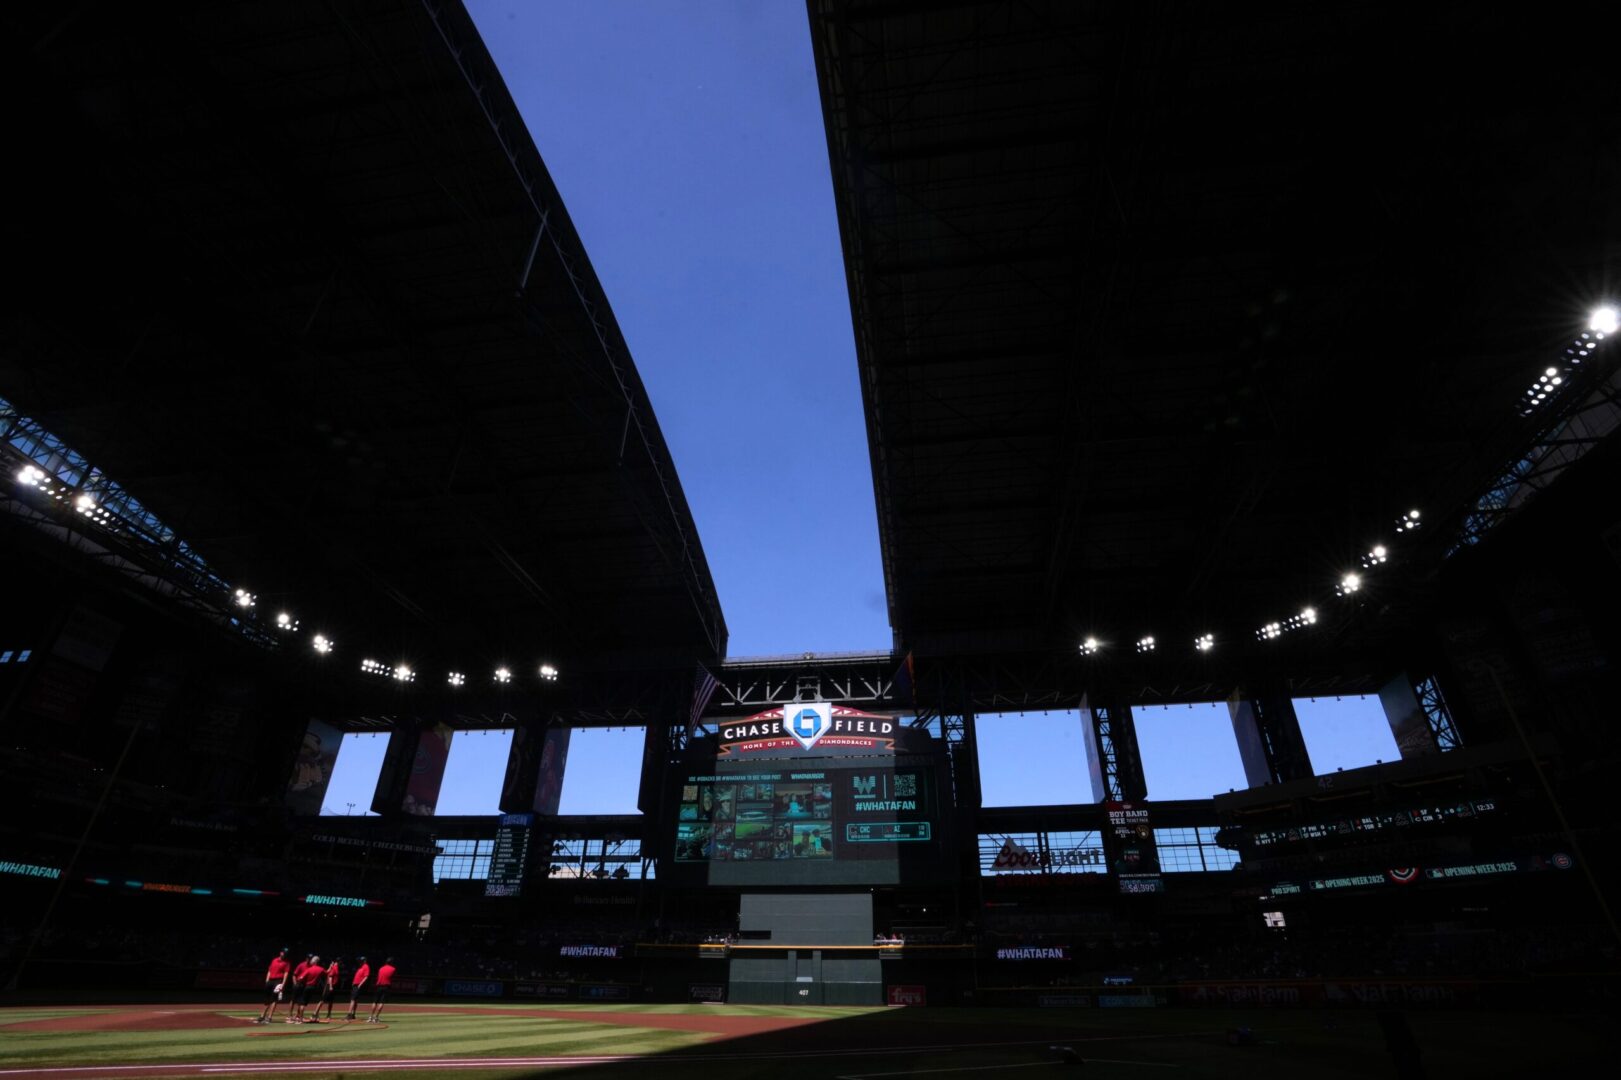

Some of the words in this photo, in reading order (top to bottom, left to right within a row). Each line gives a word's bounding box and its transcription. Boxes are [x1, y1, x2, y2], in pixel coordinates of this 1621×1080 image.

[724, 722, 780, 739] CHASE
[835, 720, 892, 734] FIELD
[856, 800, 916, 812] #WHATAFAN
[995, 846, 1049, 868] Coors
[1050, 848, 1100, 866] LIGHT
[1444, 866, 1476, 877] OPENING
[1475, 864, 1497, 874] WEEK
[1496, 861, 1517, 872] 2025
[1325, 878, 1352, 888] OPENING
[1351, 876, 1368, 886] WEEK
[1368, 874, 1385, 884] 2025
[305, 893, 366, 908] #WHATAFAN
[560, 946, 617, 957] #WHATAFAN
[997, 947, 1064, 960] #WHATAFAN
